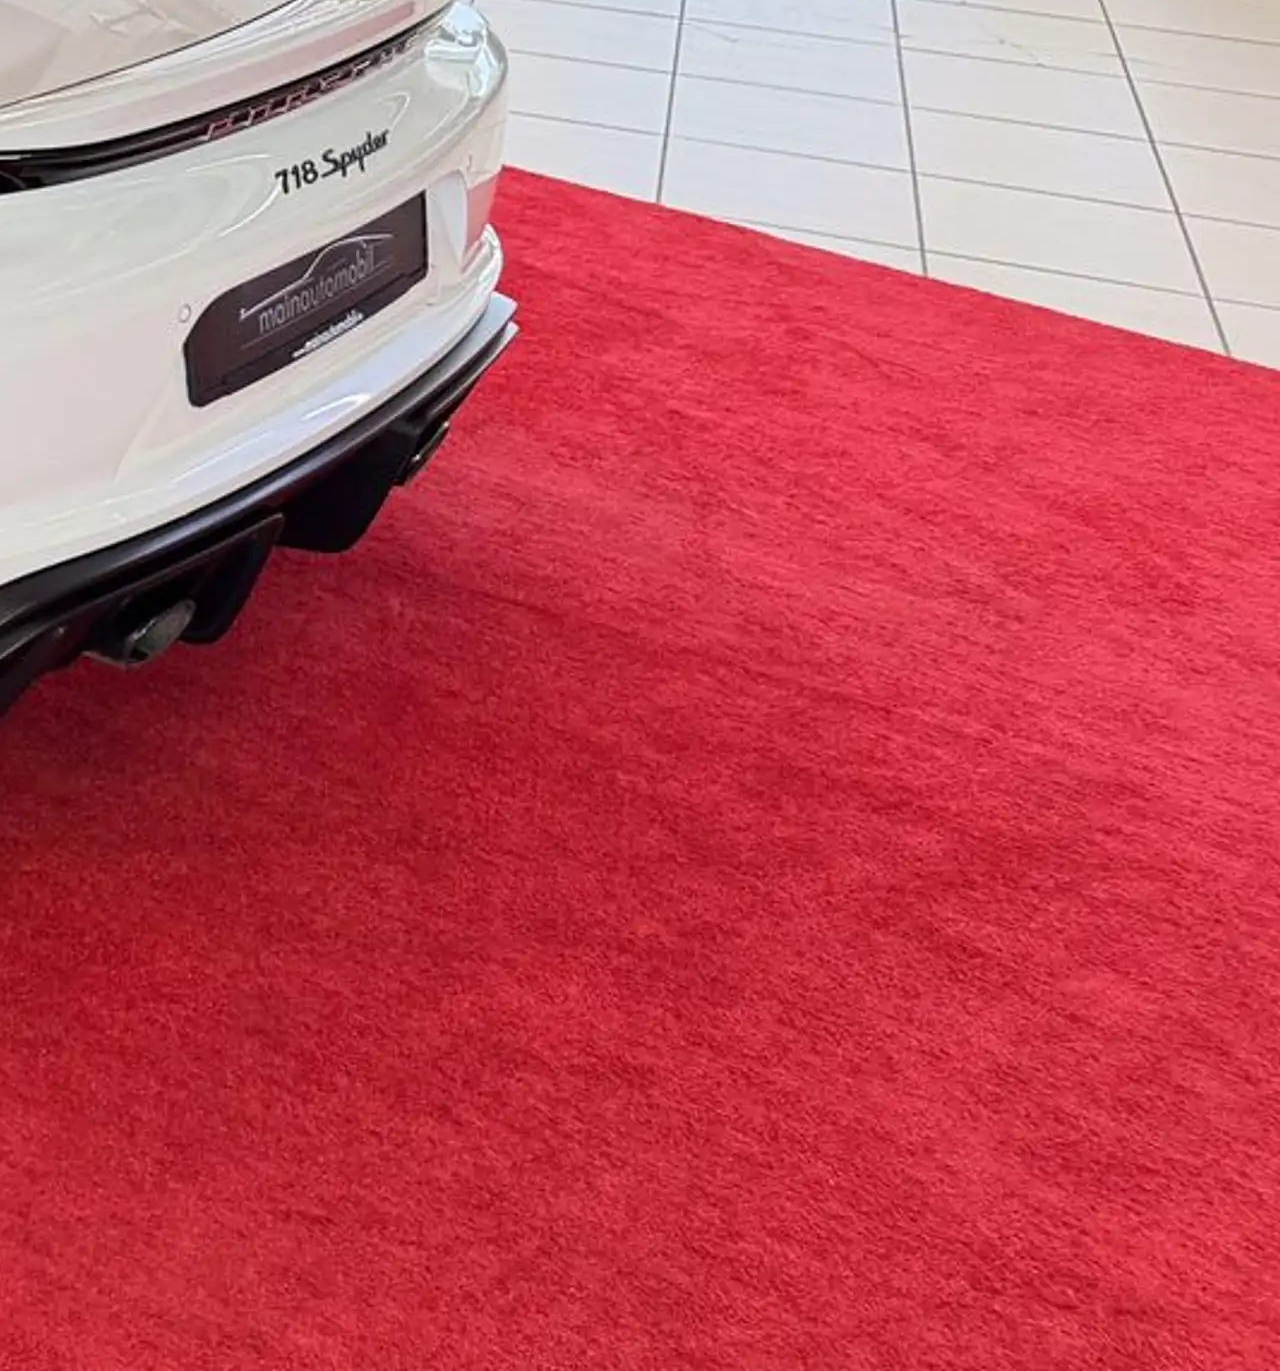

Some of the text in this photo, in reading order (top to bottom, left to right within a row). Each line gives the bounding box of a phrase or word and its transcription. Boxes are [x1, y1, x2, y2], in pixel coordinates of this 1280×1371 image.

[273, 128, 391, 195] 718 Spyder
[257, 242, 377, 335] mainautomobil
